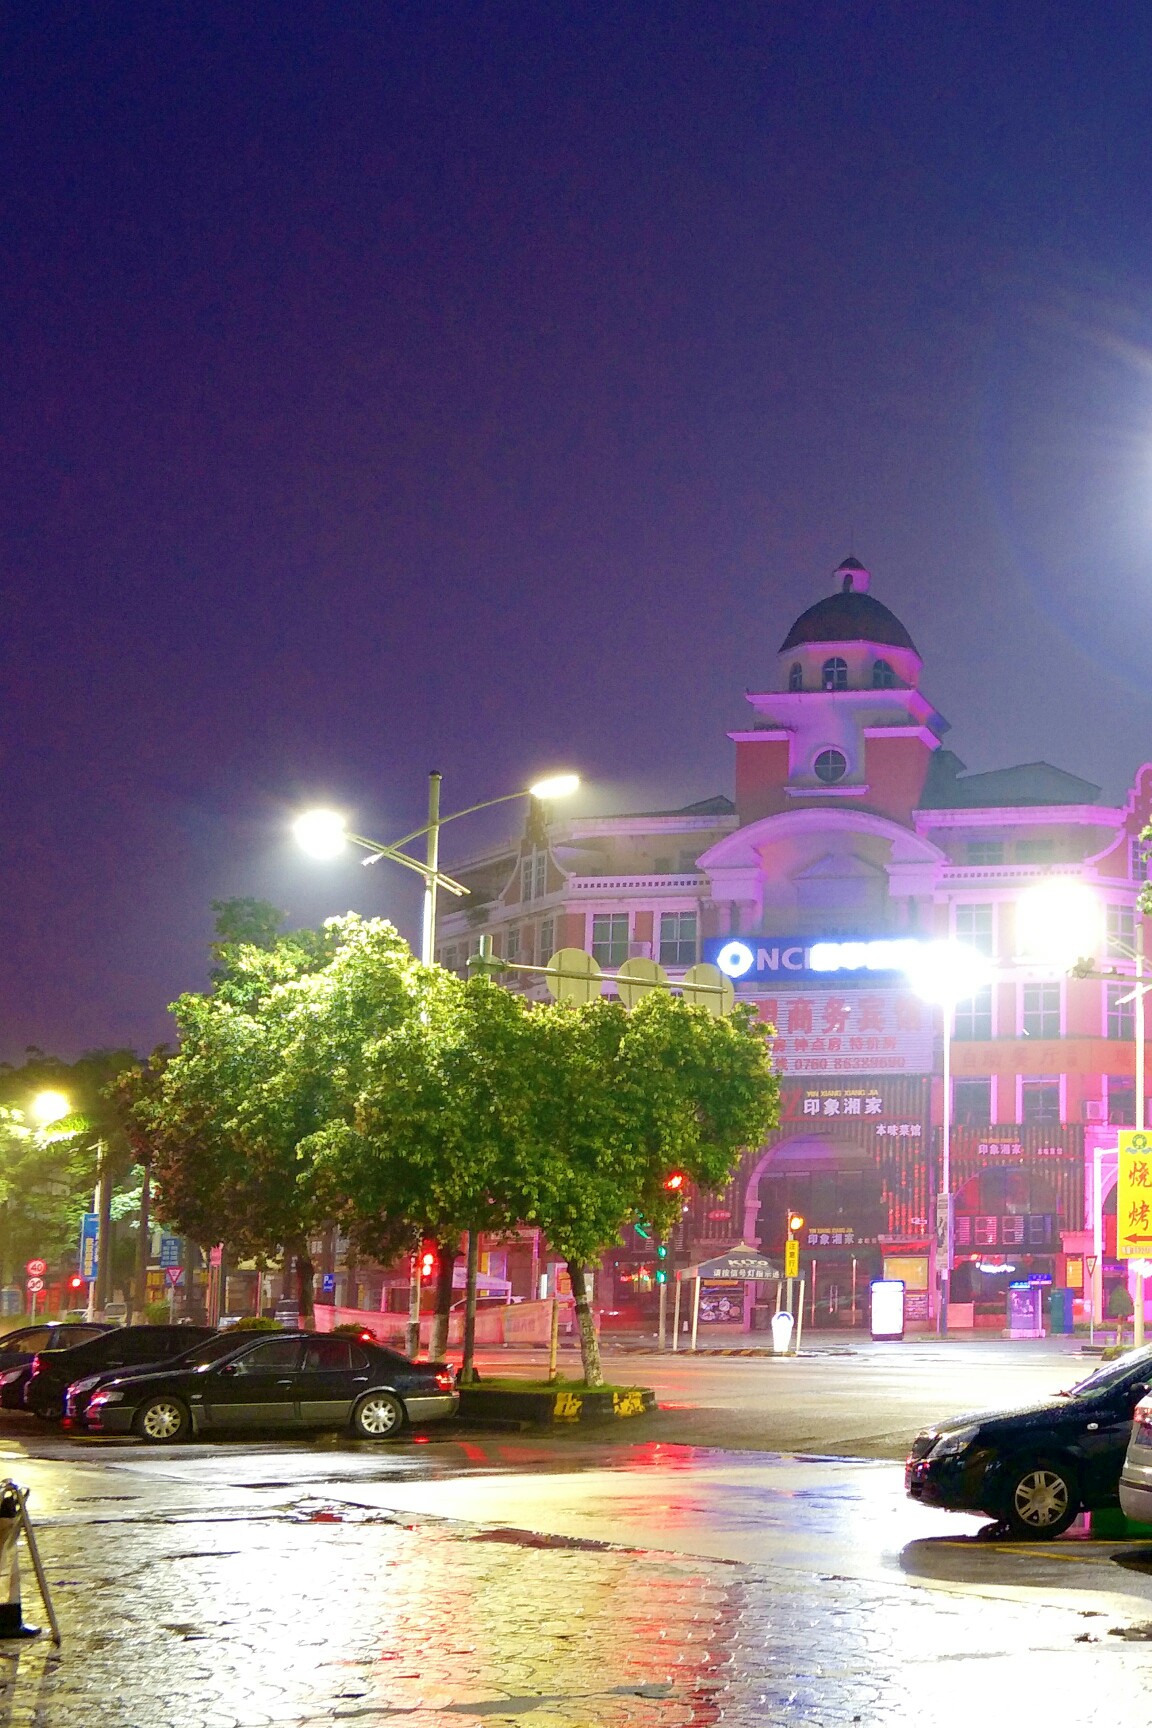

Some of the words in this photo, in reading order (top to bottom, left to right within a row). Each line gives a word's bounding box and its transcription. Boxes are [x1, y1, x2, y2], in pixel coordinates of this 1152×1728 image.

[795, 1058, 828, 1070] 0760
[803, 1097, 882, 1116] 印象湘家
[876, 1123, 921, 1136] 本味菜馆
[1128, 1160, 1152, 1231] 烧烤
[728, 1259, 769, 1267] KITO
